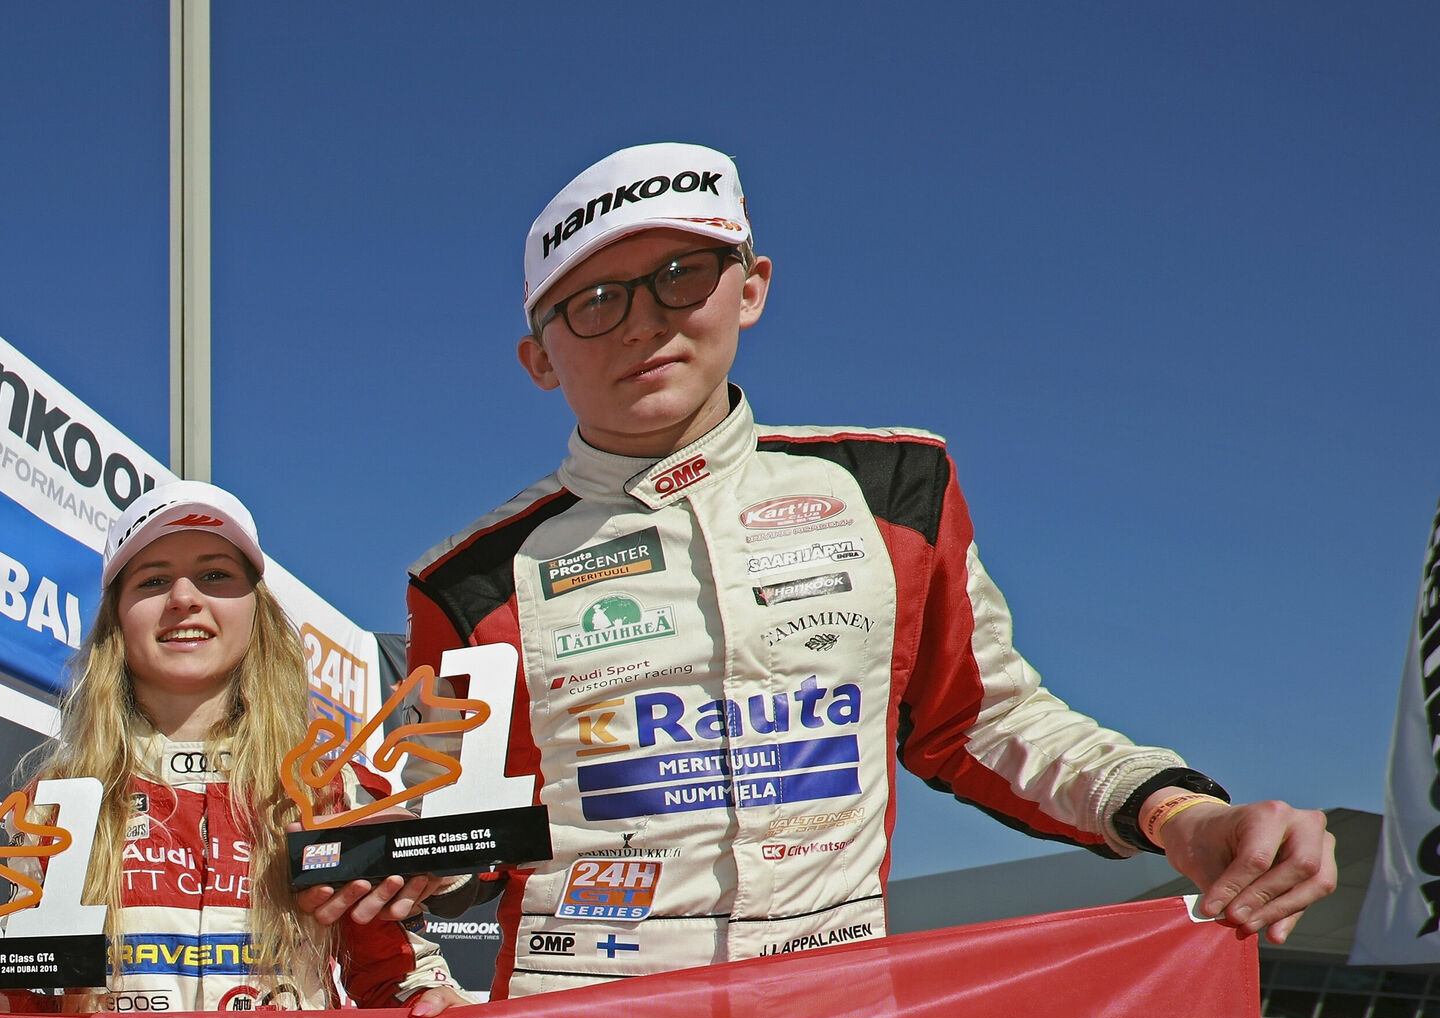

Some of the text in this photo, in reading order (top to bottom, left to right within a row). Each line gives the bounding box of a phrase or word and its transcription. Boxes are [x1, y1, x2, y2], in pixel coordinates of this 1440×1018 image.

[654, 457, 707, 494] OMP
[558, 550, 592, 567] Rauta
[571, 565, 630, 585] MERITUULI
[761, 611, 875, 647] AMMINEN
[304, 632, 365, 714] 24H
[568, 659, 651, 684] Audi Sport
[569, 662, 694, 696] customer racing
[634, 674, 863, 748] Rauta
[421, 642, 536, 818] 1
[658, 749, 777, 776] MERITUULI
[394, 828, 491, 848] WINNER Class GT4
[305, 843, 340, 857] 24H
[392, 840, 496, 859] HANKOOK 24H DUBAI 2018
[304, 862, 337, 870] SERIES
[572, 862, 657, 888] 24H
[122, 869, 165, 890] TT
[569, 887, 651, 904] GT
[563, 905, 644, 918] SERIES
[529, 935, 575, 952] OMP
[9, 953, 34, 964] Class
[36, 952, 55, 963] GT4
[1, 966, 15, 974] 24H
[16, 965, 38, 973] DUBAI
[39, 964, 58, 973] 2018
